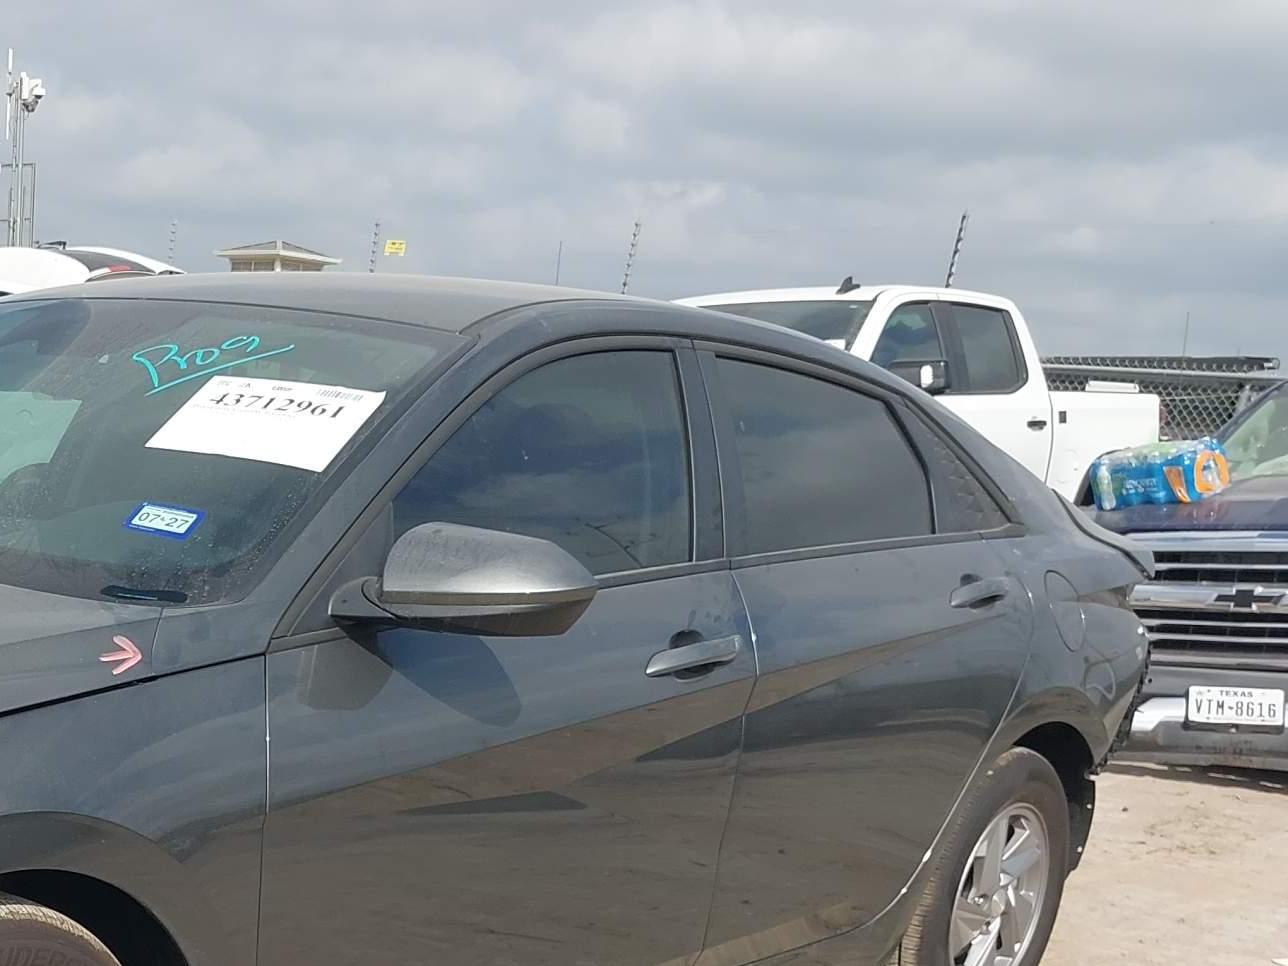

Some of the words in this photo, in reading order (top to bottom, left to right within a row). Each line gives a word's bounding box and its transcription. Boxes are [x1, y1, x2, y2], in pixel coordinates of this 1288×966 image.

[210, 392, 345, 419] 43712961
[138, 512, 161, 524] 07
[164, 517, 189, 529] 27
[1219, 690, 1254, 698] TEXAS
